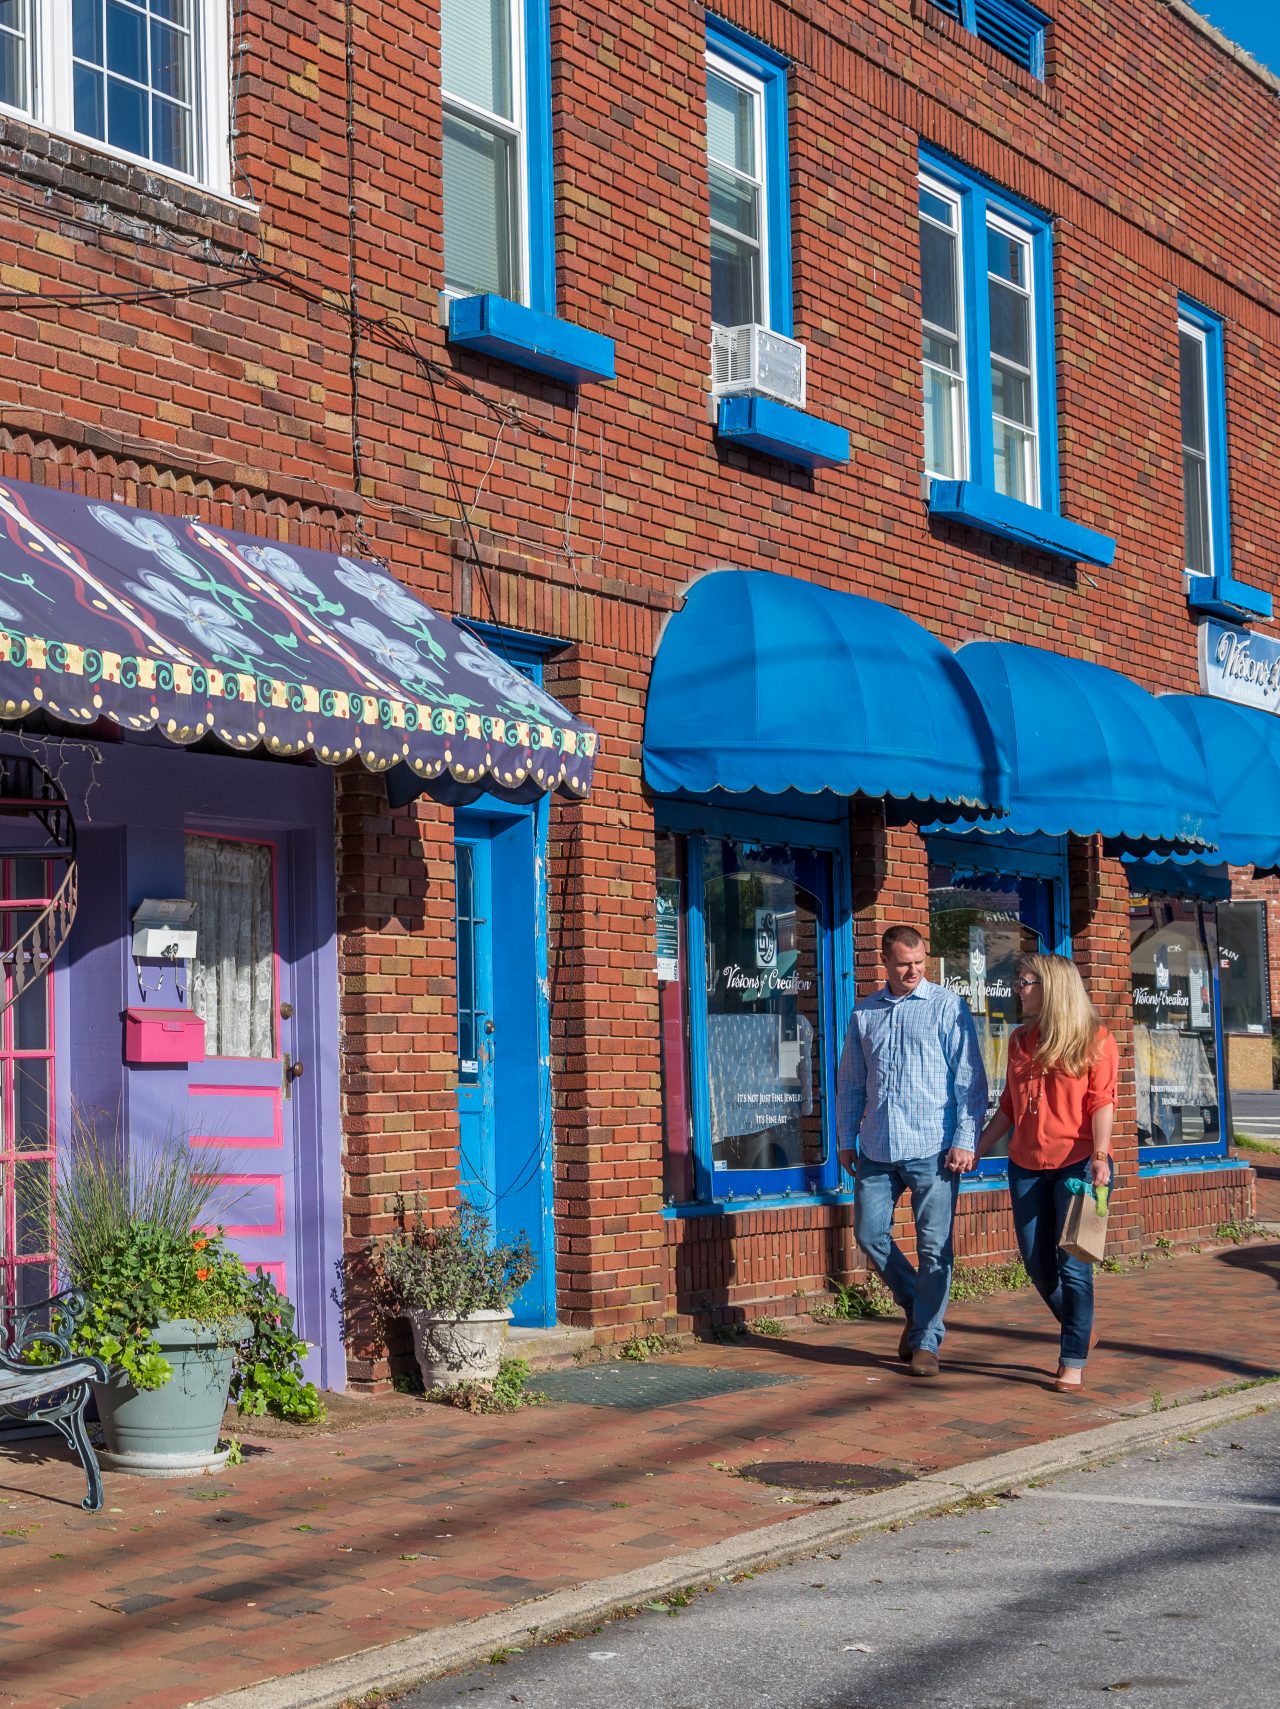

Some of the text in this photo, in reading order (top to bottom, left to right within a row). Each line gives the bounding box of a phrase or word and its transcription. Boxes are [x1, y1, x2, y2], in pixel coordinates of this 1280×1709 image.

[723, 964, 759, 989] Visions
[768, 969, 811, 990] Creation
[1133, 987, 1159, 1005] Visions
[1162, 990, 1189, 1006] Creation
[747, 1093, 759, 1103] NOT
[759, 1093, 771, 1104] JUST
[771, 1093, 783, 1103] FINE
[765, 1114, 777, 1124] FINE
[777, 1114, 788, 1124] ART
